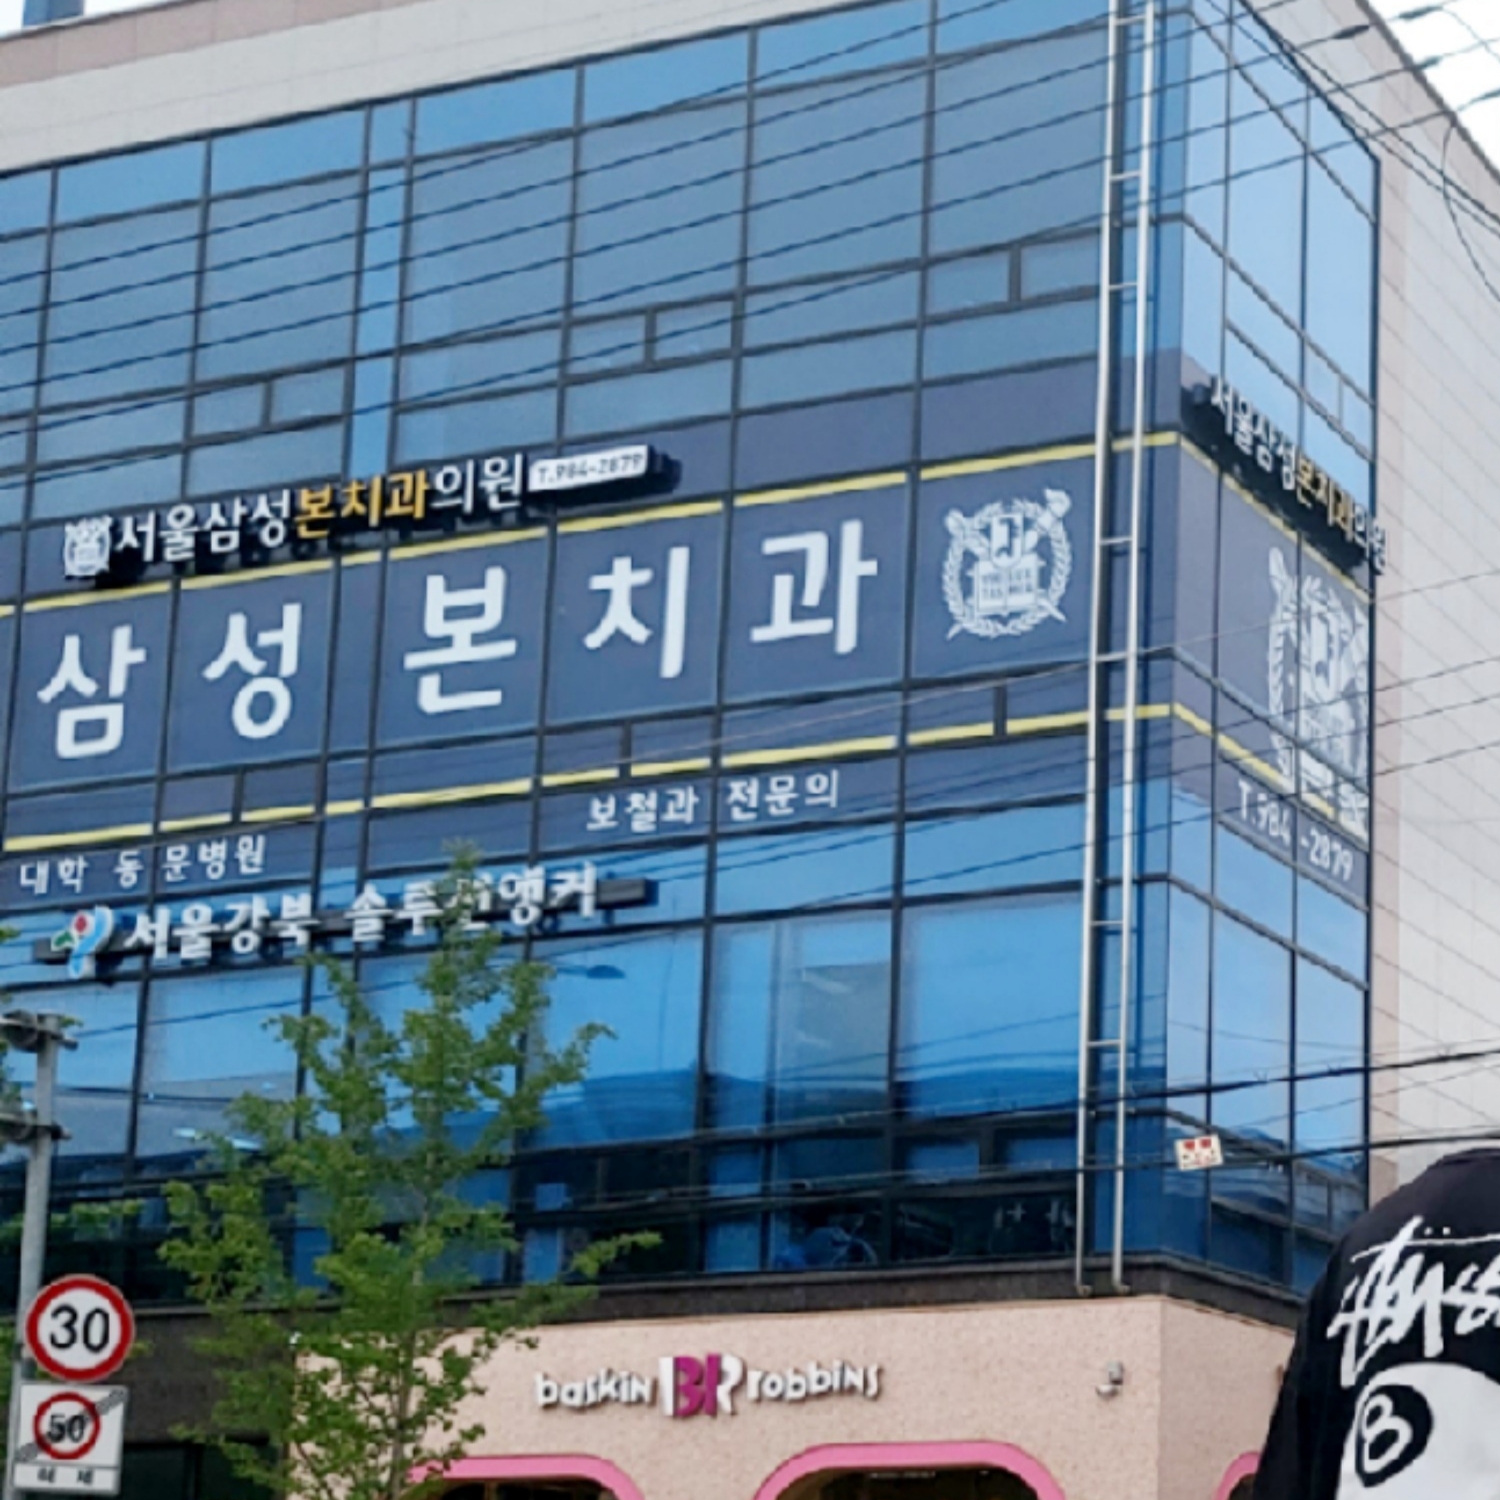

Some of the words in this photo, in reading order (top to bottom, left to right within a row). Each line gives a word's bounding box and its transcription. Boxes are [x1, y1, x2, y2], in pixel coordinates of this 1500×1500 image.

[115, 452, 524, 564] 서울삼성본치과의원
[586, 785, 698, 832] 보철과
[725, 769, 840, 822] 전문의
[19, 855, 89, 894] 대학
[113, 834, 266, 889] 동문병원
[123, 892, 321, 960] 서울강북
[50, 1304, 110, 1354] 30
[535, 1370, 654, 1412] baskin
[47, 1412, 86, 1445] 50
